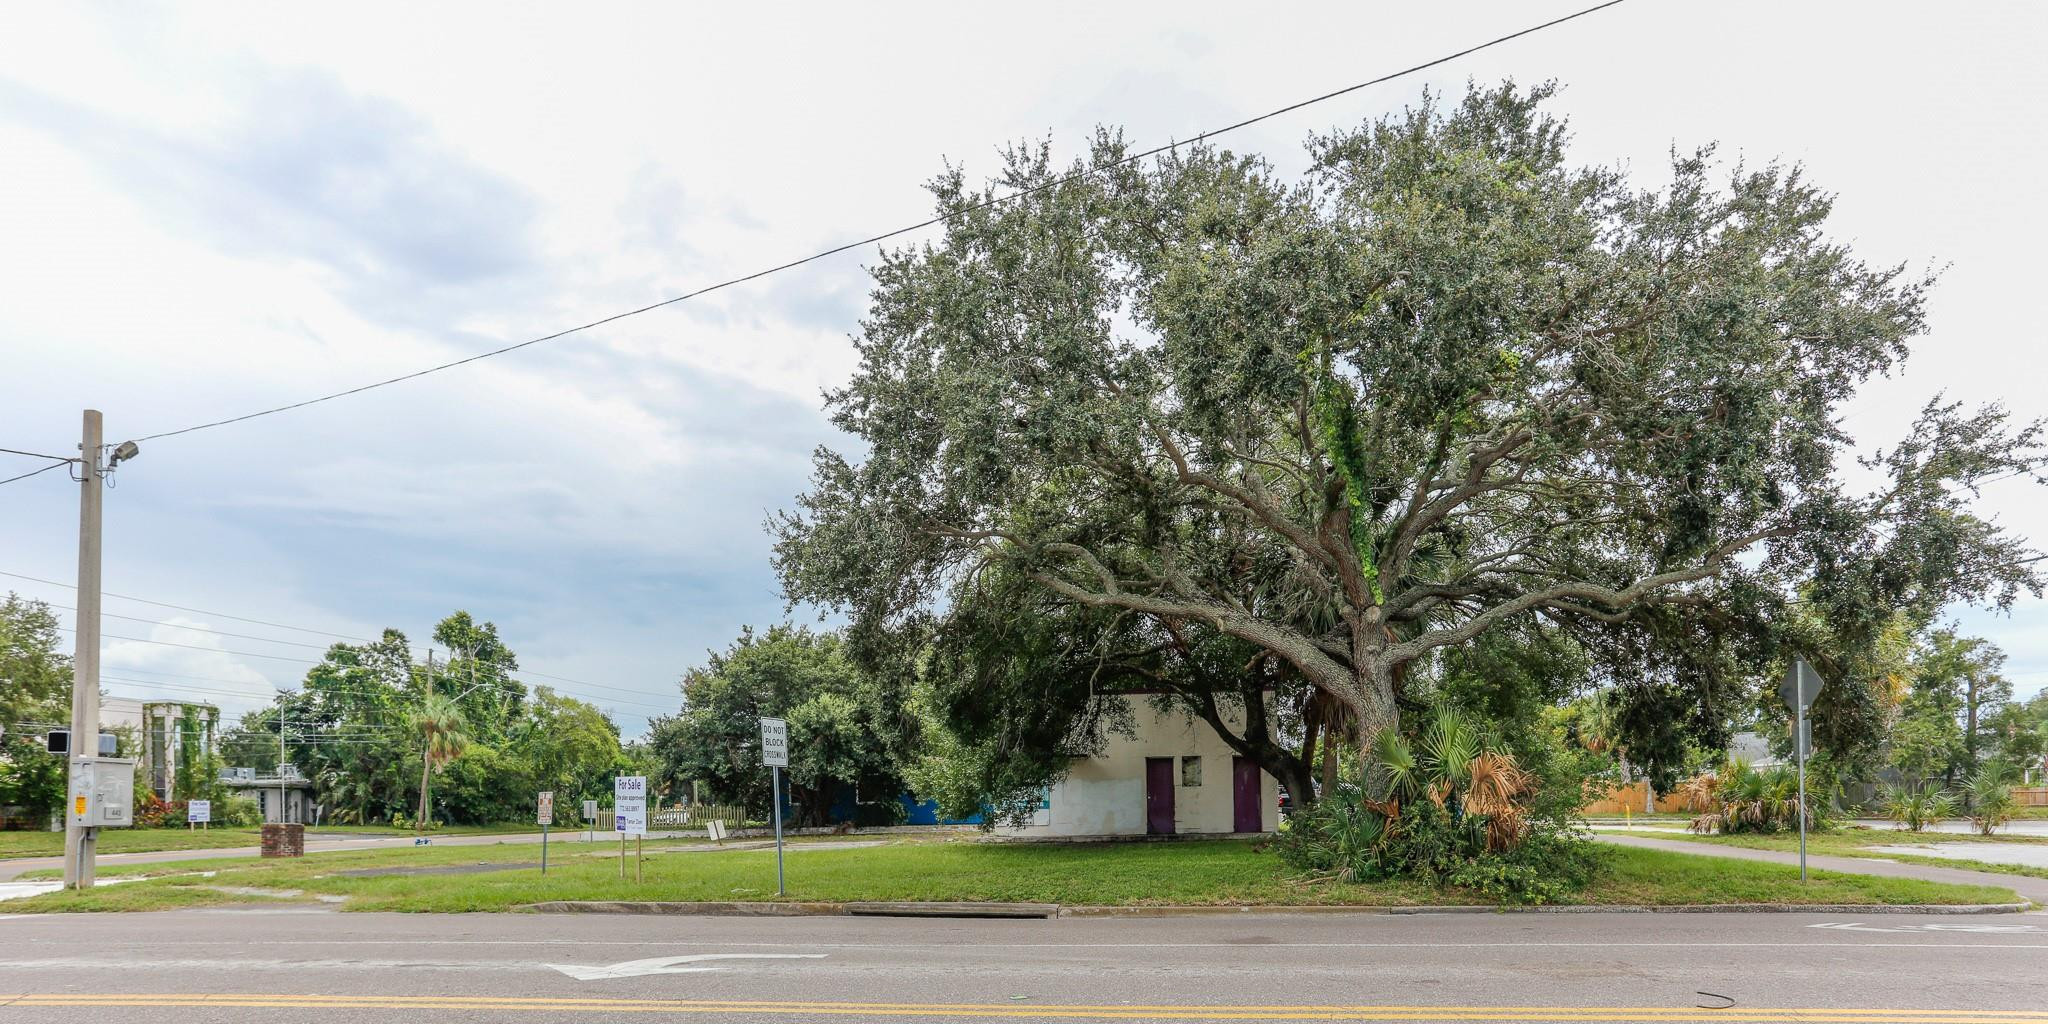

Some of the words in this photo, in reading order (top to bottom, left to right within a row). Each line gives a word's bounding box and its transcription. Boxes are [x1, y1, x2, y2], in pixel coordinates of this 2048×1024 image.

[763, 724, 772, 734] DO
[773, 726, 784, 735] NOT
[765, 737, 785, 747] BLOCK
[618, 779, 627, 790] For
[627, 778, 641, 790] Sale
